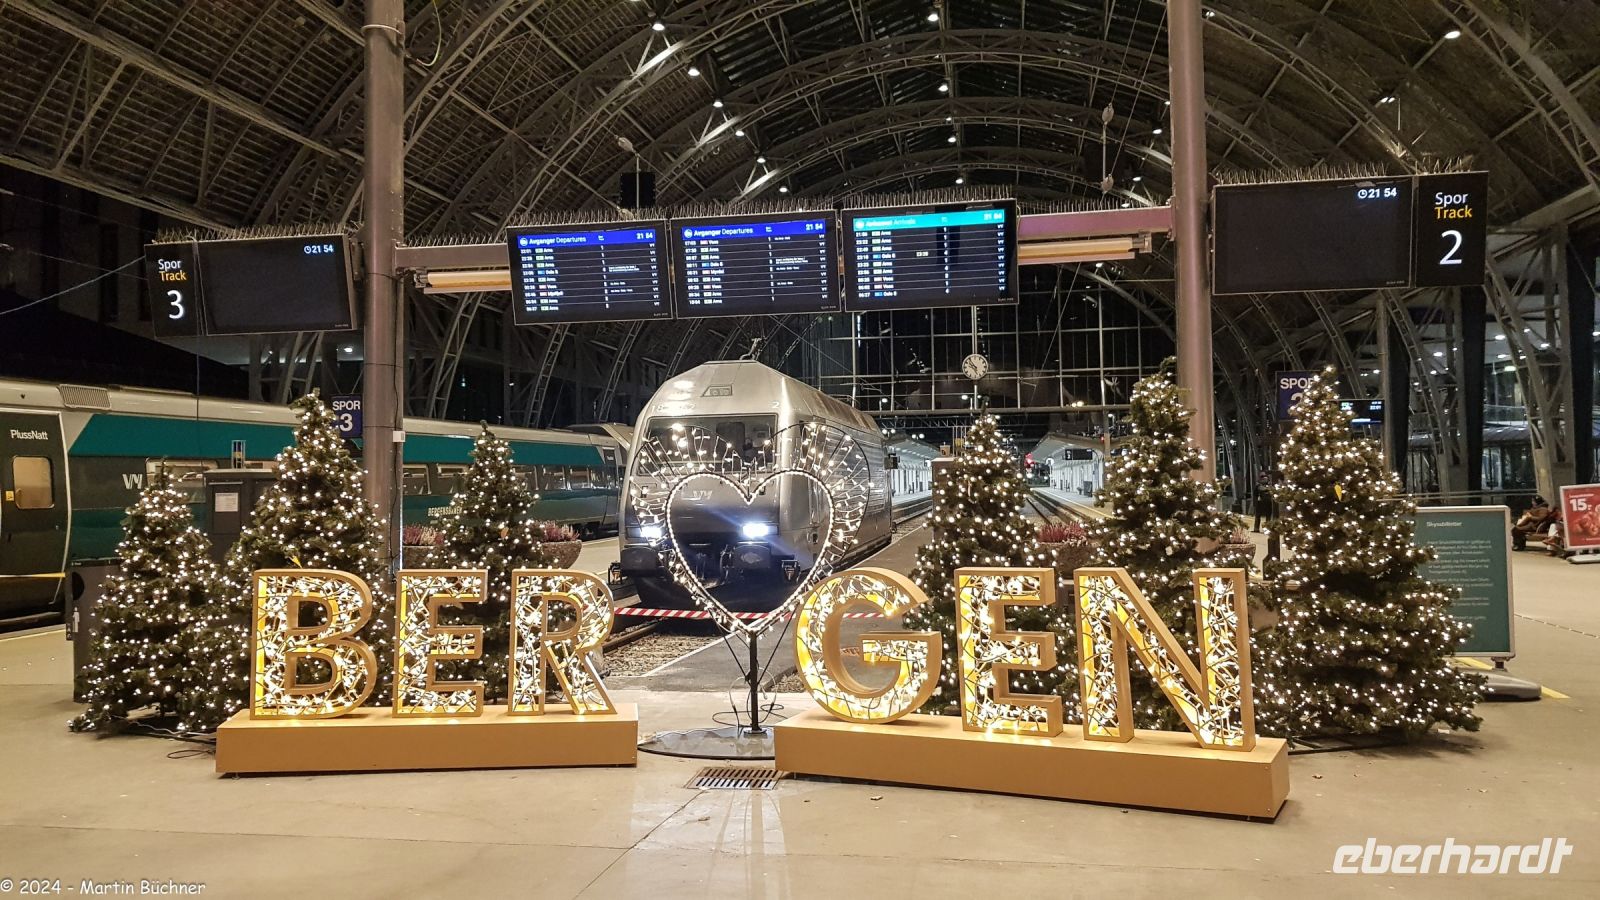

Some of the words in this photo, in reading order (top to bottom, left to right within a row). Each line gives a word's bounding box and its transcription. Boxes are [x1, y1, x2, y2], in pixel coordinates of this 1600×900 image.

[1368, 188, 1380, 198] 21
[1384, 188, 1397, 198] 54
[1434, 192, 1468, 208] Spor
[1434, 205, 1472, 219] Track
[323, 244, 334, 252] 54
[1439, 229, 1462, 265] 2
[158, 258, 182, 271] Spor
[159, 270, 187, 281] Track
[166, 289, 184, 320] 3
[332, 401, 360, 410] SPOR
[340, 413, 354, 432] 3
[10, 429, 48, 440] PlussNatt
